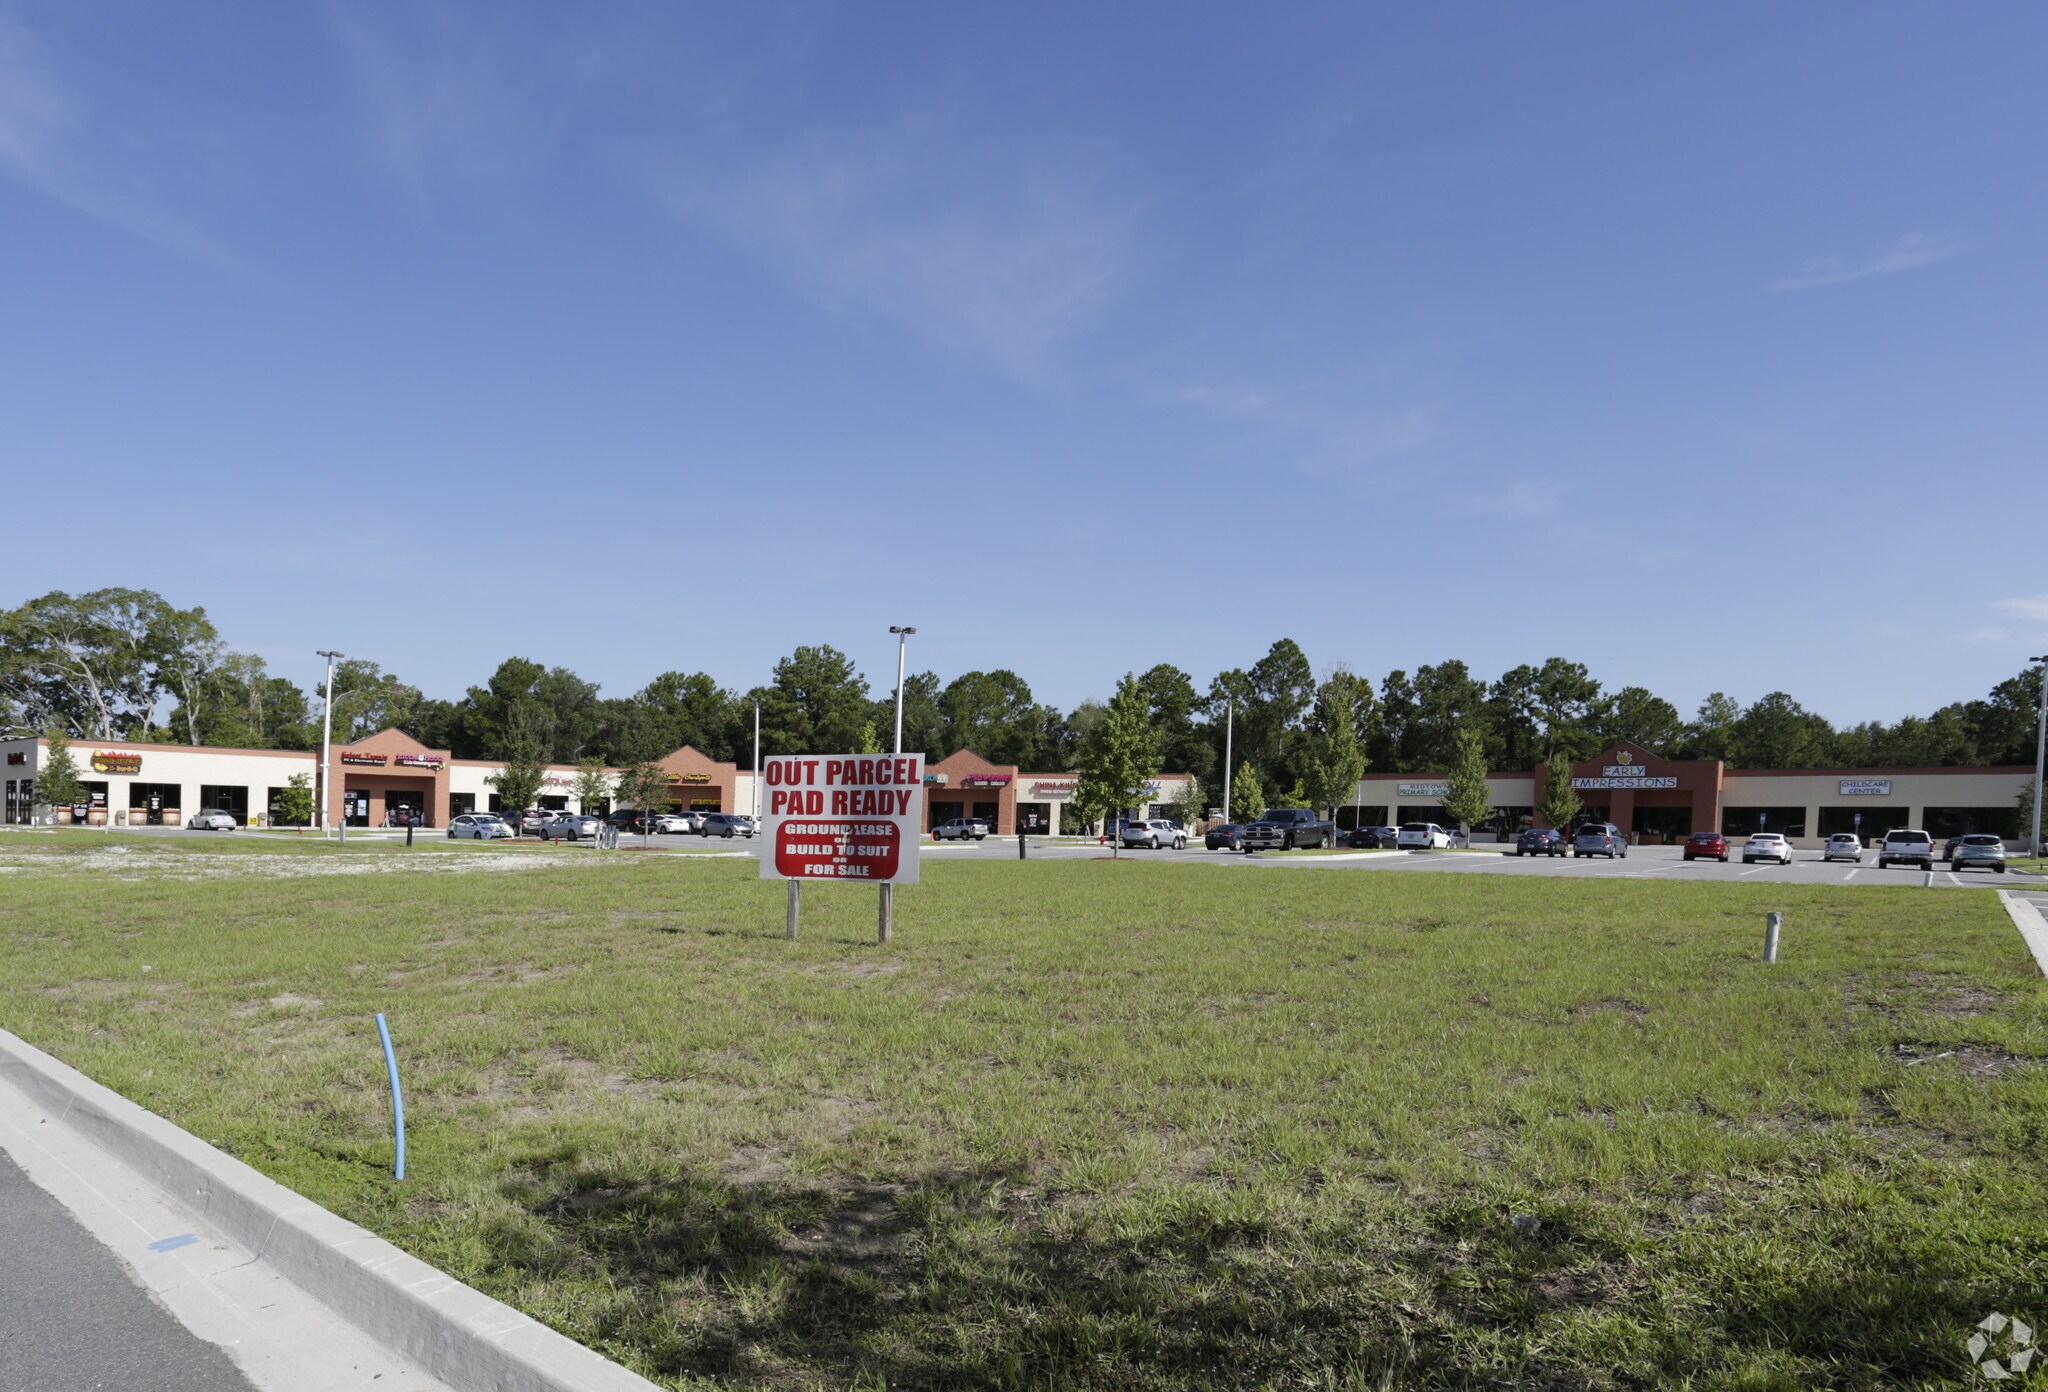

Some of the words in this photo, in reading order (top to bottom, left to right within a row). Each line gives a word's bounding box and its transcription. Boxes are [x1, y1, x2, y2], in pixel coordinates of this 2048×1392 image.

[766, 760, 819, 786] OUT
[826, 759, 920, 785] PARCEL
[1603, 766, 1645, 776] EARLY
[1034, 781, 1057, 789] CHINA
[1573, 778, 1676, 788] IMPRESSIONS
[772, 790, 824, 815] PAD
[832, 790, 912, 815] READY
[785, 824, 852, 835] GROUND
[854, 825, 893, 835] LEASE
[786, 844, 833, 855] BUILD
[836, 845, 853, 856] TO
[857, 846, 890, 856] SUIT
[804, 864, 835, 875] FOR
[838, 865, 870, 876] SALE
